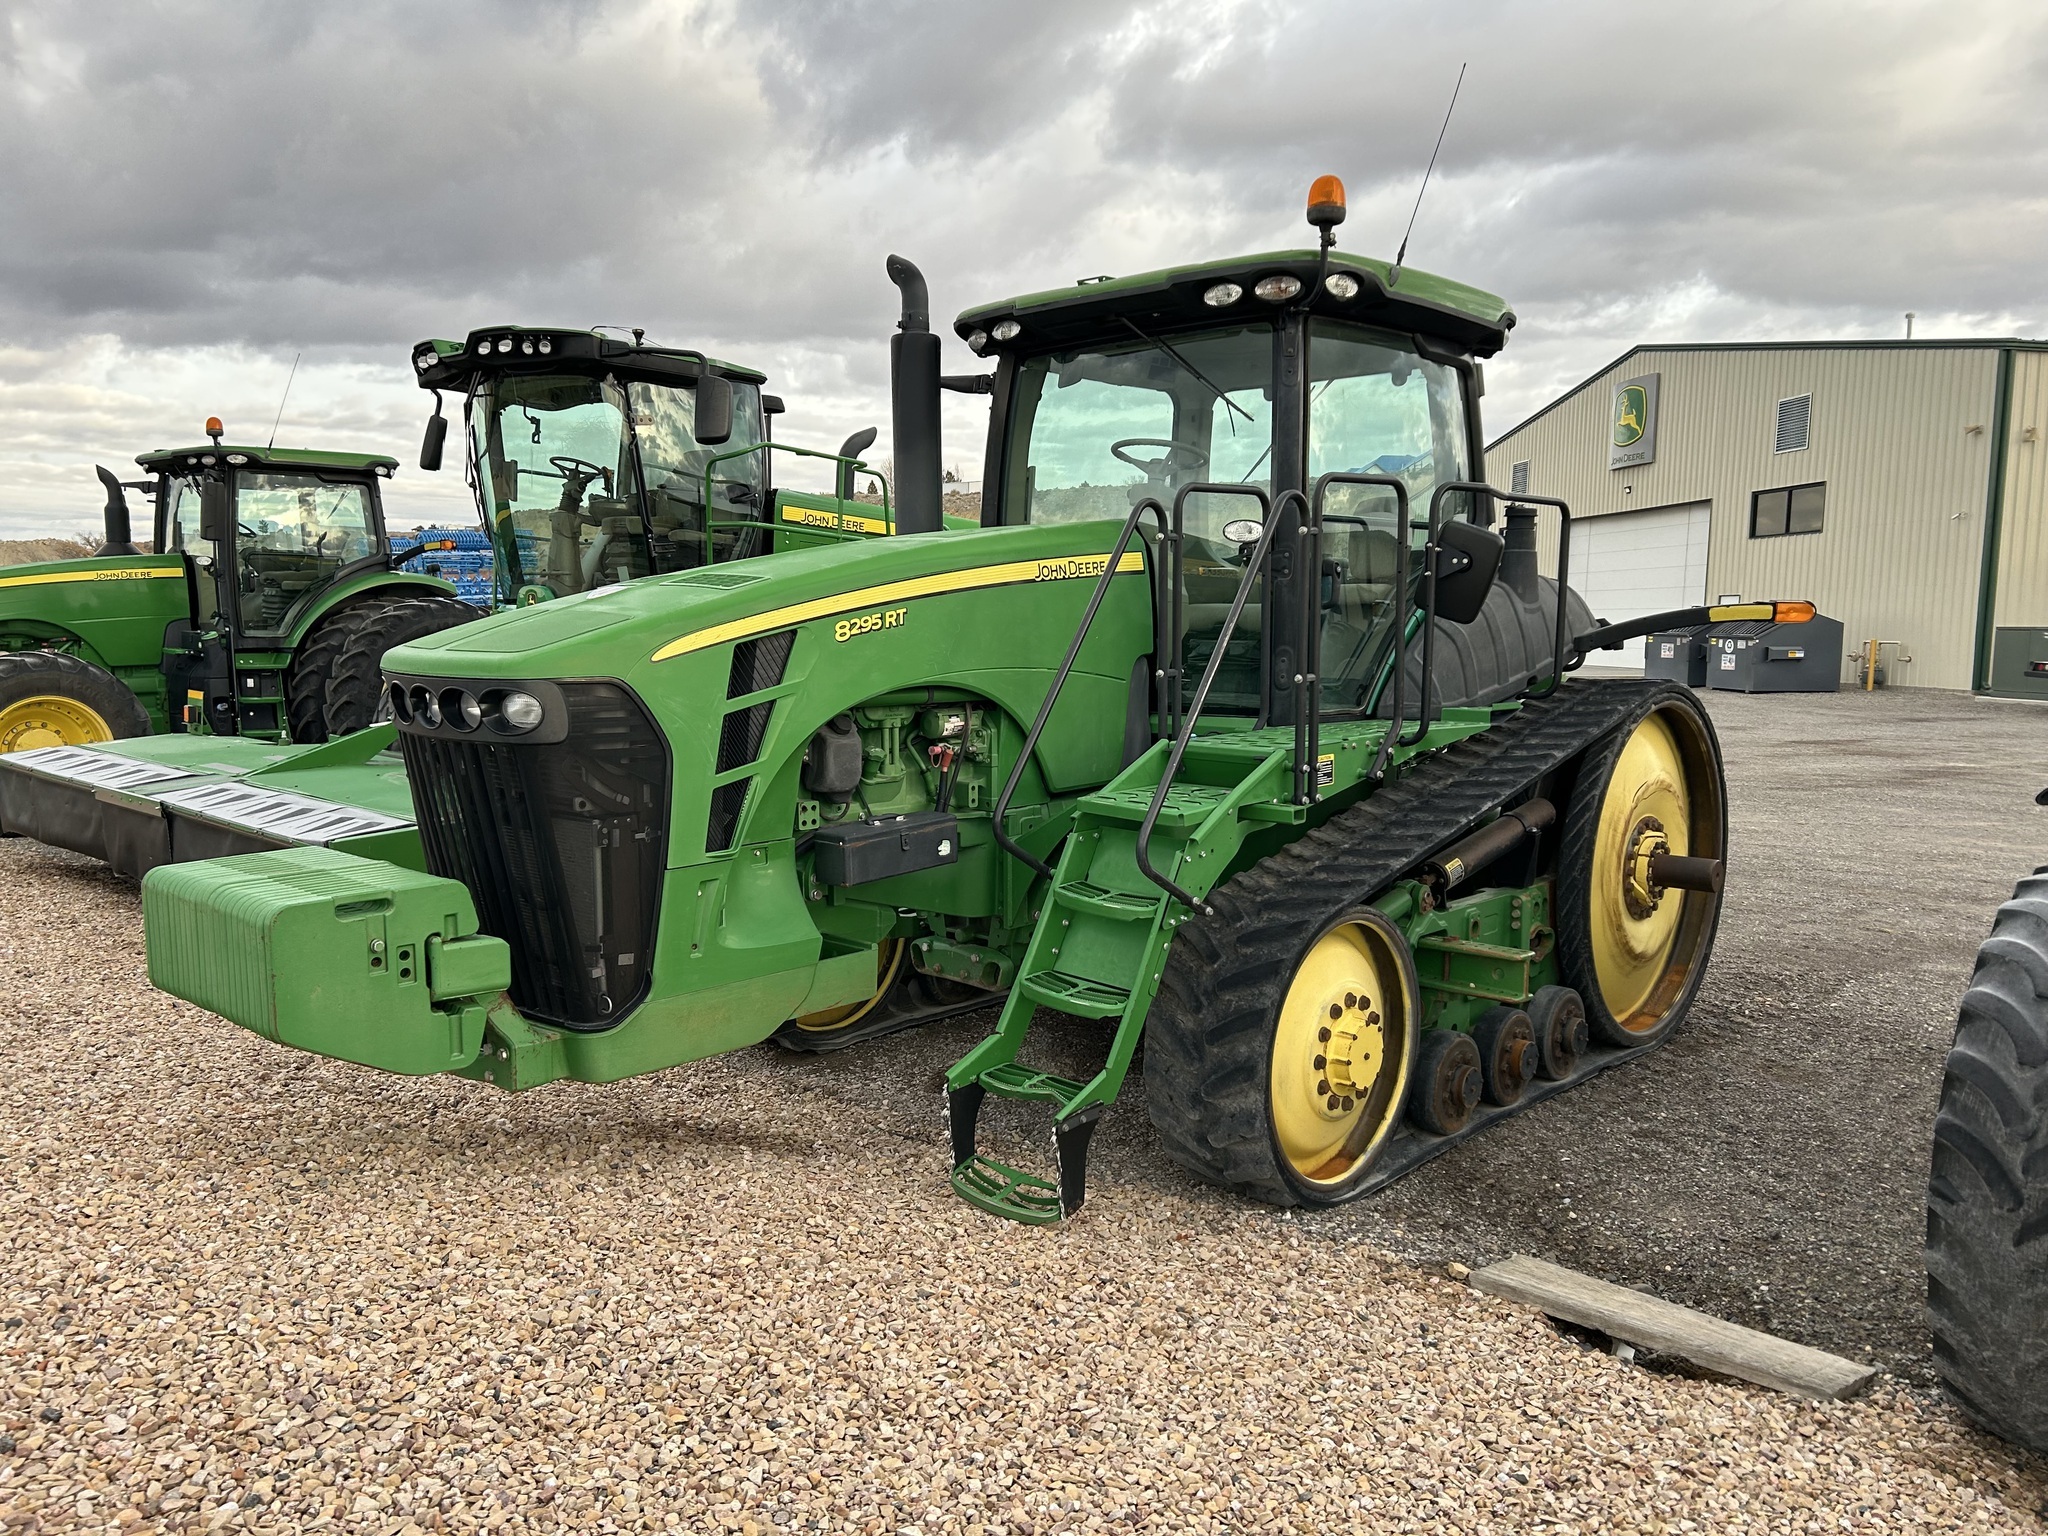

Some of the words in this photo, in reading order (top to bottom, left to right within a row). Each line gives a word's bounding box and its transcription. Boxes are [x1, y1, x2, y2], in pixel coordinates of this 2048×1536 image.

[1611, 456, 1624, 466] JOHN
[1624, 452, 1645, 462] DEERE
[801, 512, 830, 526] JOHN
[832, 516, 865, 530] DEERE
[94, 572, 119, 580] JOHN
[121, 571, 152, 579] DEERE
[1035, 563, 1067, 579] JOHN
[1068, 561, 1105, 576] DEERE
[834, 613, 883, 642] 8295
[885, 608, 907, 629] RT
